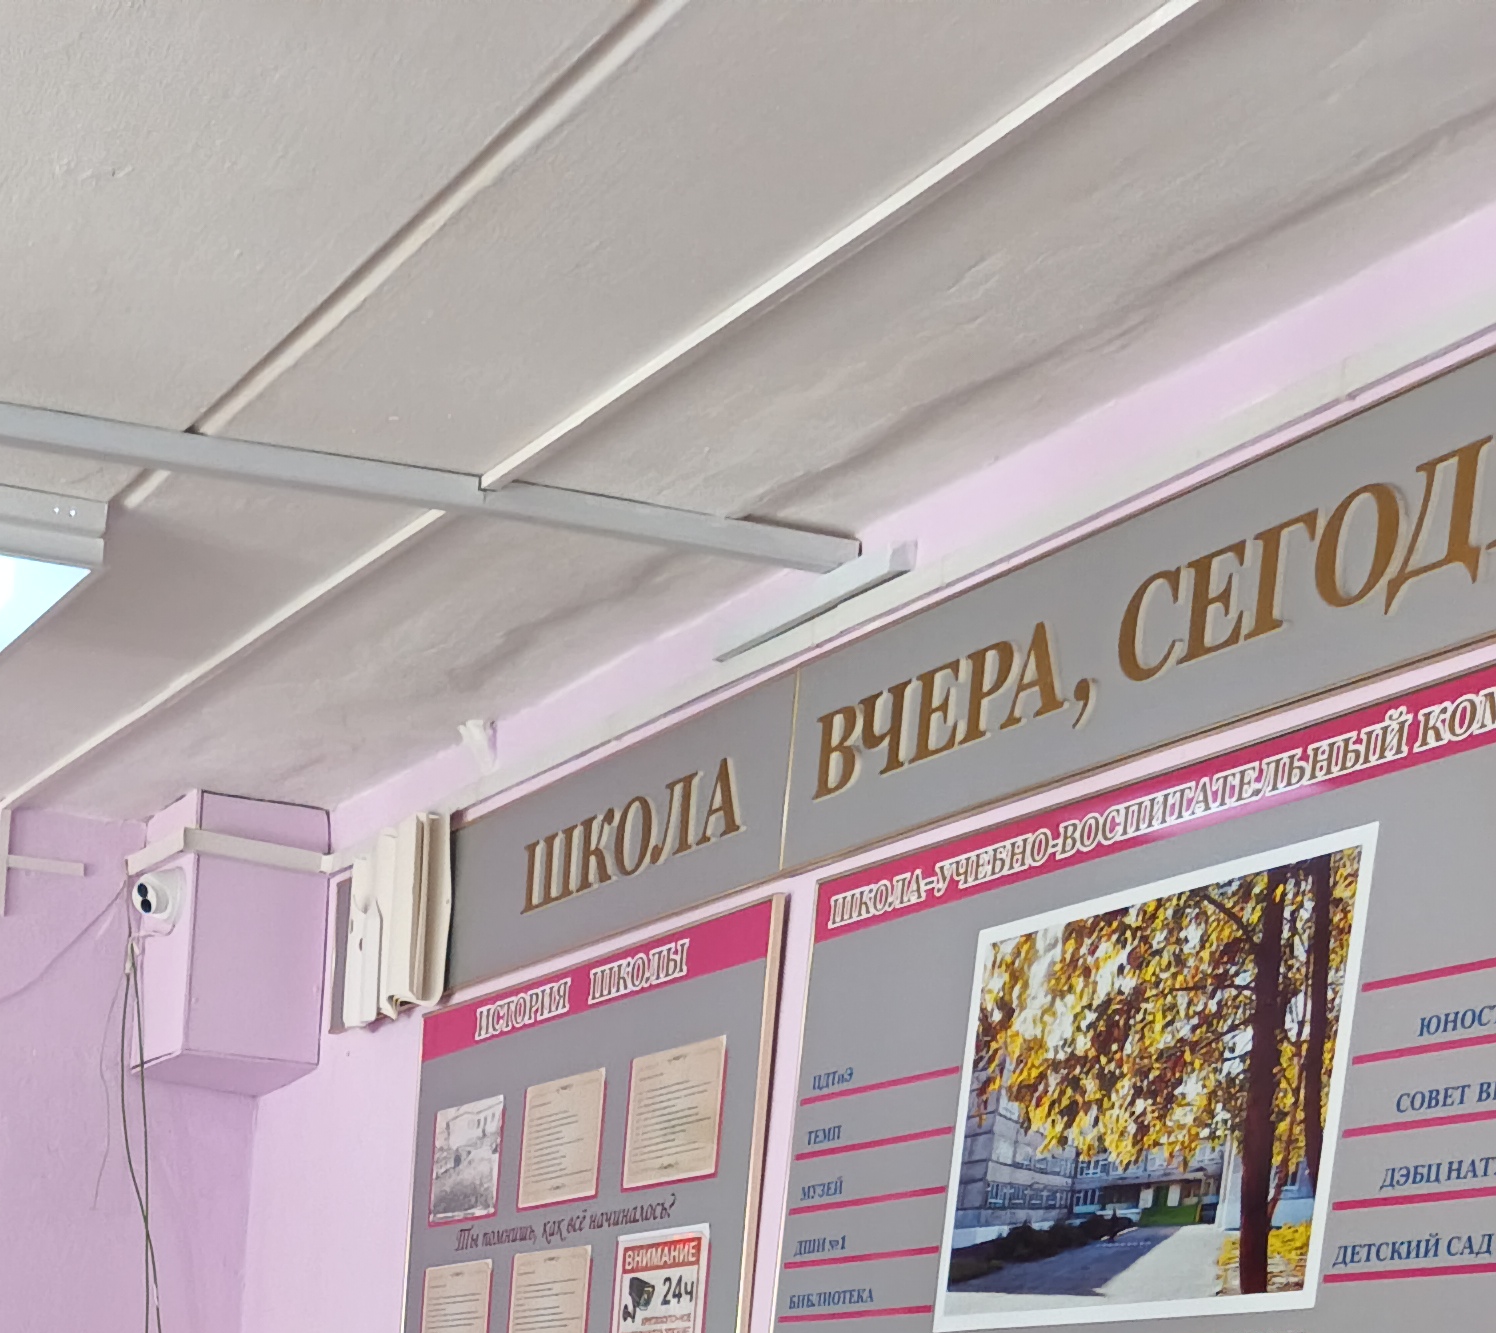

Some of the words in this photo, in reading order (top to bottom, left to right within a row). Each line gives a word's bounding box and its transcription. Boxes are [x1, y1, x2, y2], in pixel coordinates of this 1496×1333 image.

[521, 758, 742, 915] ШКОЛА
[814, 621, 1096, 800] ВЧЕРА,
[1118, 435, 1496, 682] СЕГОД
[476, 979, 570, 1039] ИСТОРИЯ
[590, 941, 689, 1003] ШКОЛЫ
[1417, 1005, 1496, 1037] ЮНОС
[1396, 1084, 1471, 1113] СОВЕТ
[807, 1125, 843, 1146] ТЕМП
[800, 1176, 843, 1201] МУЗЕЙ
[1379, 1162, 1442, 1192] ДЭБЦ
[1445, 1157, 1496, 1181] НАТ
[625, 1241, 698, 1270] ВНИМАНИЕ
[1332, 1233, 1442, 1267] ДЕТСКИЙ
[1446, 1233, 1494, 1258] САД
[660, 1274, 695, 1306] 24ч
[789, 1288, 874, 1310] БИБЛИОТЕКА
